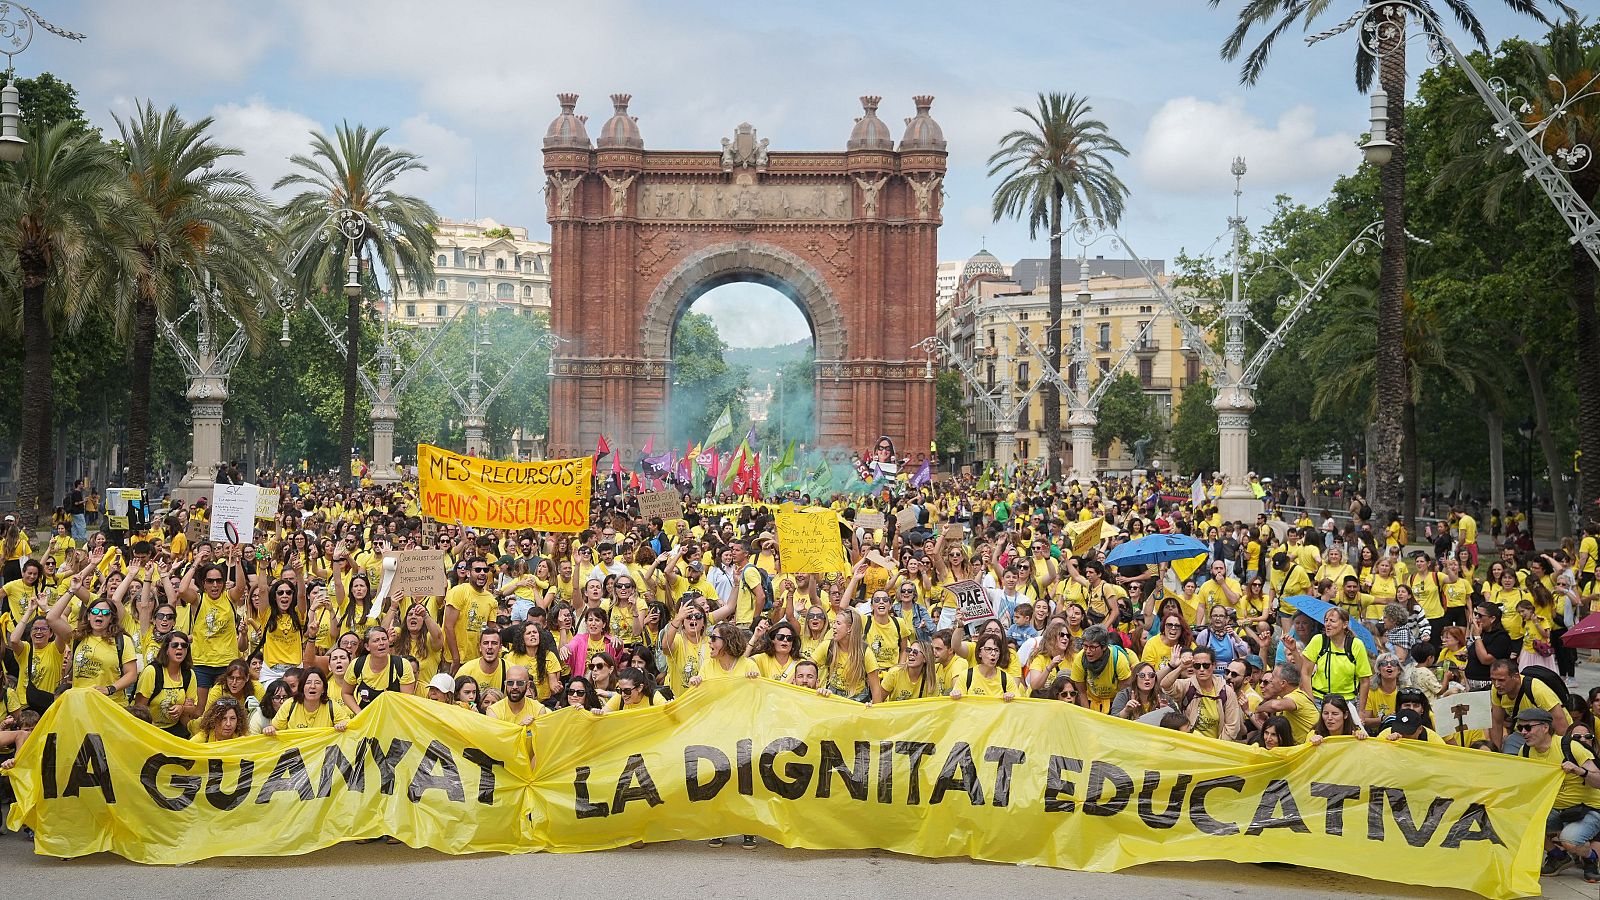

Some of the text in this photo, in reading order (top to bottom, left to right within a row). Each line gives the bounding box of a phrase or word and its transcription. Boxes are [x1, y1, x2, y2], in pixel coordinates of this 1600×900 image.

[429, 454, 575, 487] MÉS RECURSOS
[226, 485, 241, 494] CV
[426, 491, 585, 527] MENYS DISCURSOS
[957, 588, 985, 608] PAE
[140, 736, 504, 811] GUANYAT
[574, 753, 665, 820] LA
[684, 736, 1026, 808] DIGNITAT
[1044, 754, 1508, 849] EDUCATIVA
